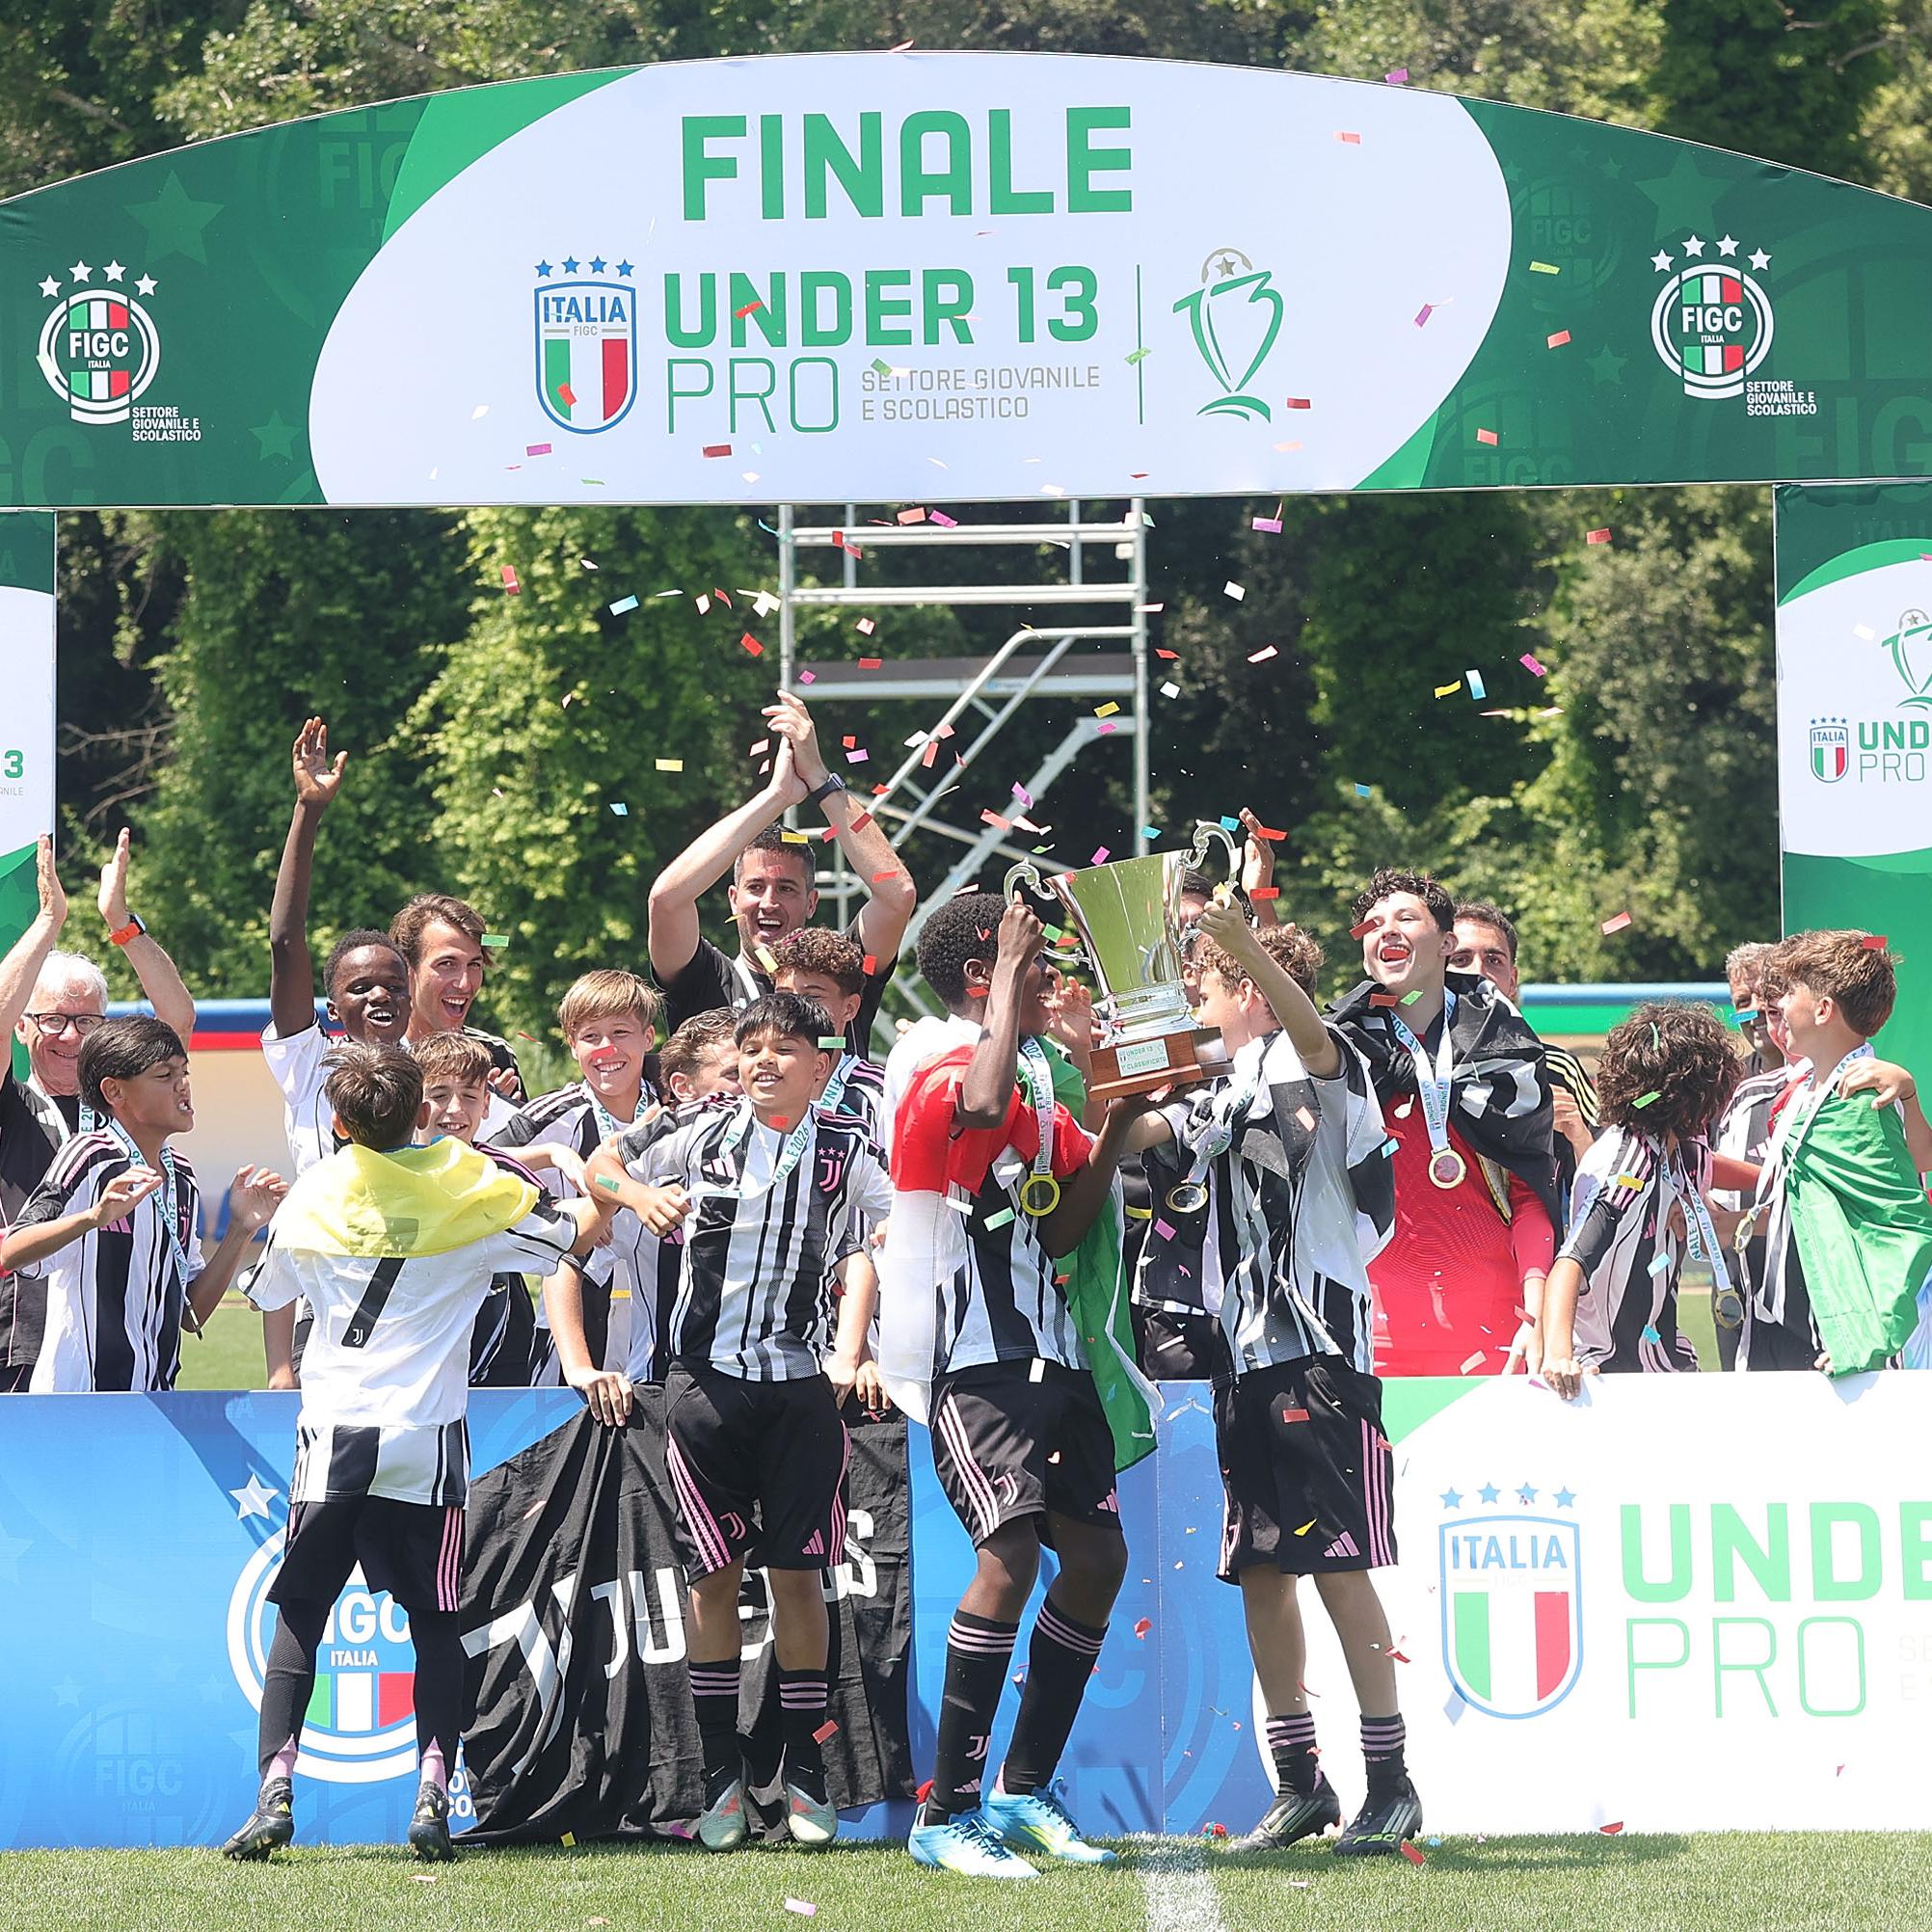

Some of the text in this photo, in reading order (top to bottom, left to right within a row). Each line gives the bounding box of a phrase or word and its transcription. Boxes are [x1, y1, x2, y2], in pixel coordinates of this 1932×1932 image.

[682, 106, 1133, 221] FINALE
[543, 296, 628, 323] ITALIA
[664, 265, 1099, 348] UNDER 13
[574, 325, 598, 335] FIGC
[1681, 307, 1743, 333] FIGC
[69, 332, 129, 358] FIGC
[1701, 335, 1724, 343] ITALIA
[975, 365, 1100, 389] GIOVANILE
[1746, 380, 1794, 392] SETTORE
[667, 357, 840, 434] PRO
[1746, 391, 1815, 404] GIOVANILE E
[132, 407, 178, 418] SETTORE
[862, 396, 1029, 421] E SCOLASTICO
[1747, 403, 1817, 416] SCOLASTICO
[132, 418, 200, 430] GIOVANILE E
[132, 429, 201, 442] SCOLASTICO
[1812, 731, 1845, 742] ITALIA
[1859, 721, 1930, 750] UND
[1860, 752, 1925, 783] PRO
[1126, 1047, 1146, 1058] UNDER
[791, 1124, 810, 1152] 2026
[1451, 1535, 1569, 1570] ITALIA
[322, 1592, 412, 1645] IGC
[330, 1650, 380, 1667] ITALIA
[1625, 1616, 1867, 1720] PRO
[1353, 1833, 1397, 1845] F50
